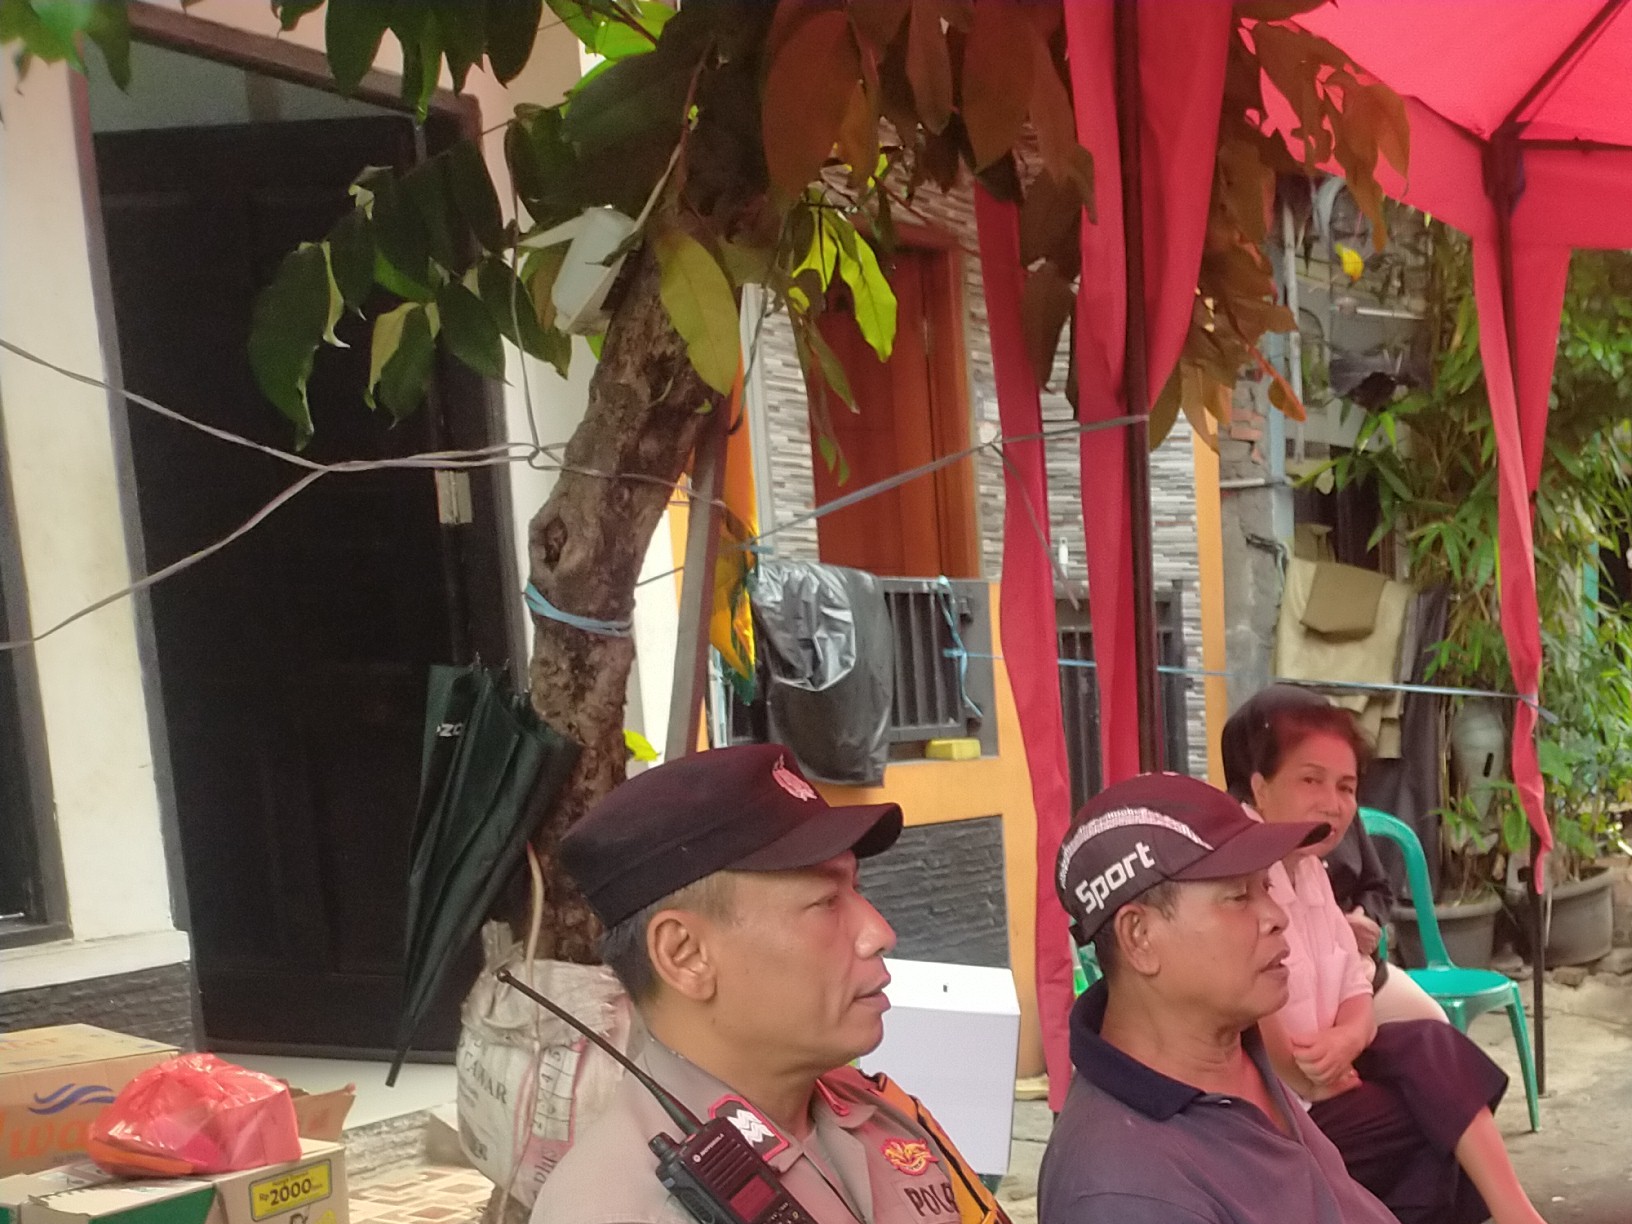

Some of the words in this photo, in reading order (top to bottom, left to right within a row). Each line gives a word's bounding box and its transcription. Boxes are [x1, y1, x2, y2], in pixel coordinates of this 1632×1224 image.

[1075, 842, 1155, 914] Sport
[270, 1179, 312, 1206] 2000
[904, 1181, 960, 1217] POLR
